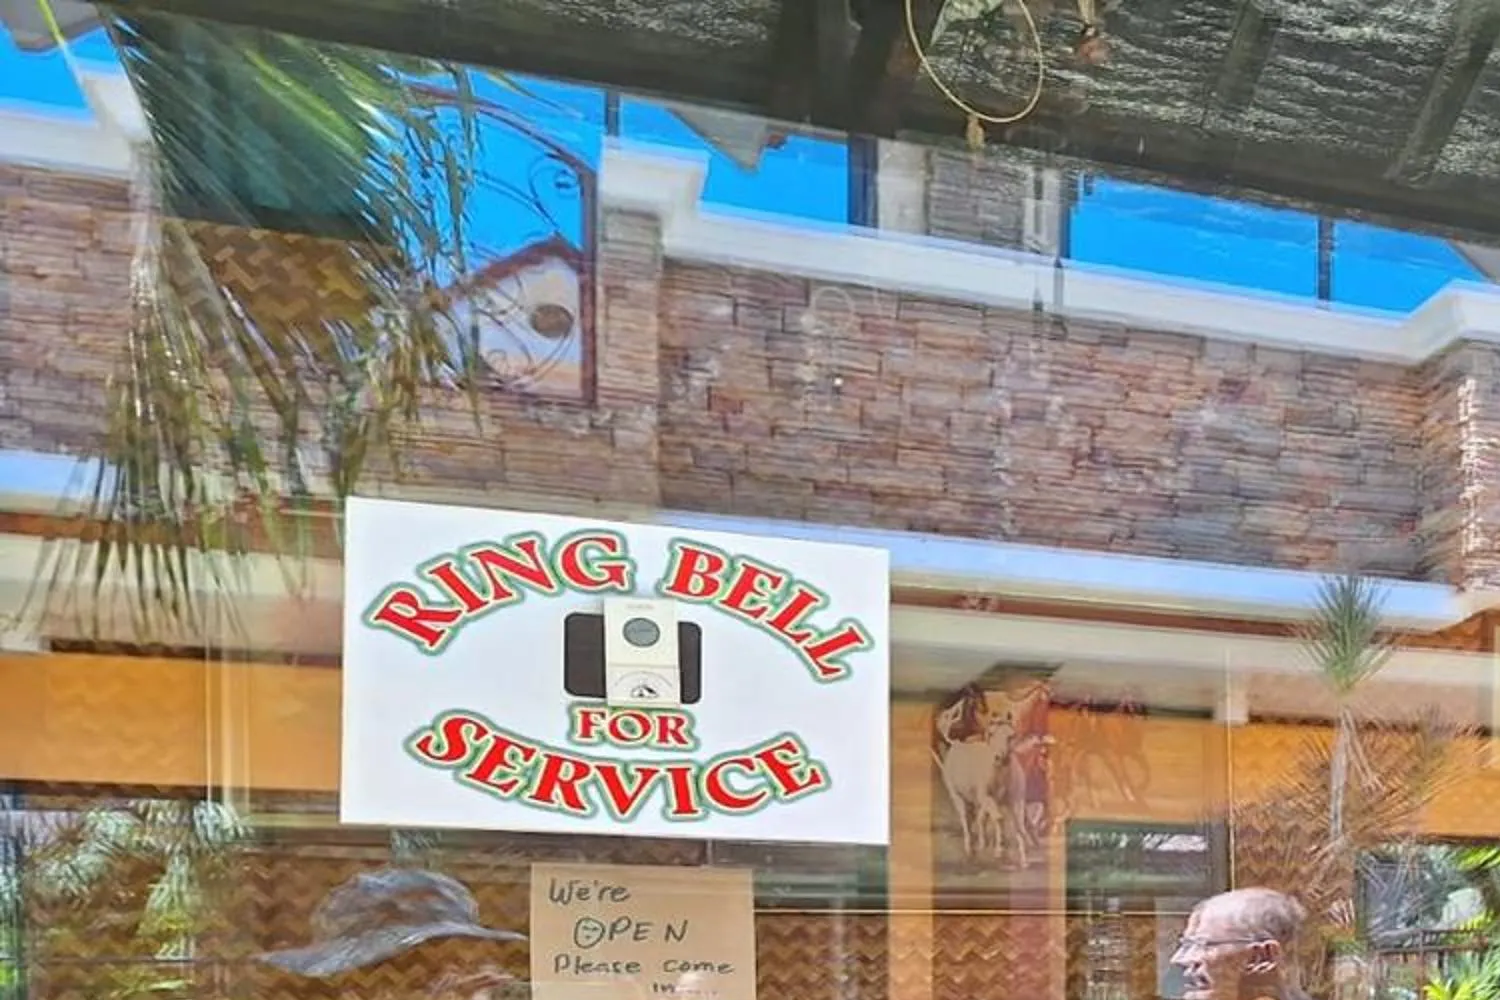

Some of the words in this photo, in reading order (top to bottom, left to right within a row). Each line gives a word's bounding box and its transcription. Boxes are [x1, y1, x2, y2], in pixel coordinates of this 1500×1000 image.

[368, 532, 633, 651] RING
[661, 543, 872, 680] BELL
[576, 708, 692, 746] FOR
[412, 715, 826, 817] SERVICE
[549, 878, 631, 904] We're
[573, 915, 689, 949] OPEN
[554, 953, 641, 975] Please
[662, 958, 736, 975] come
